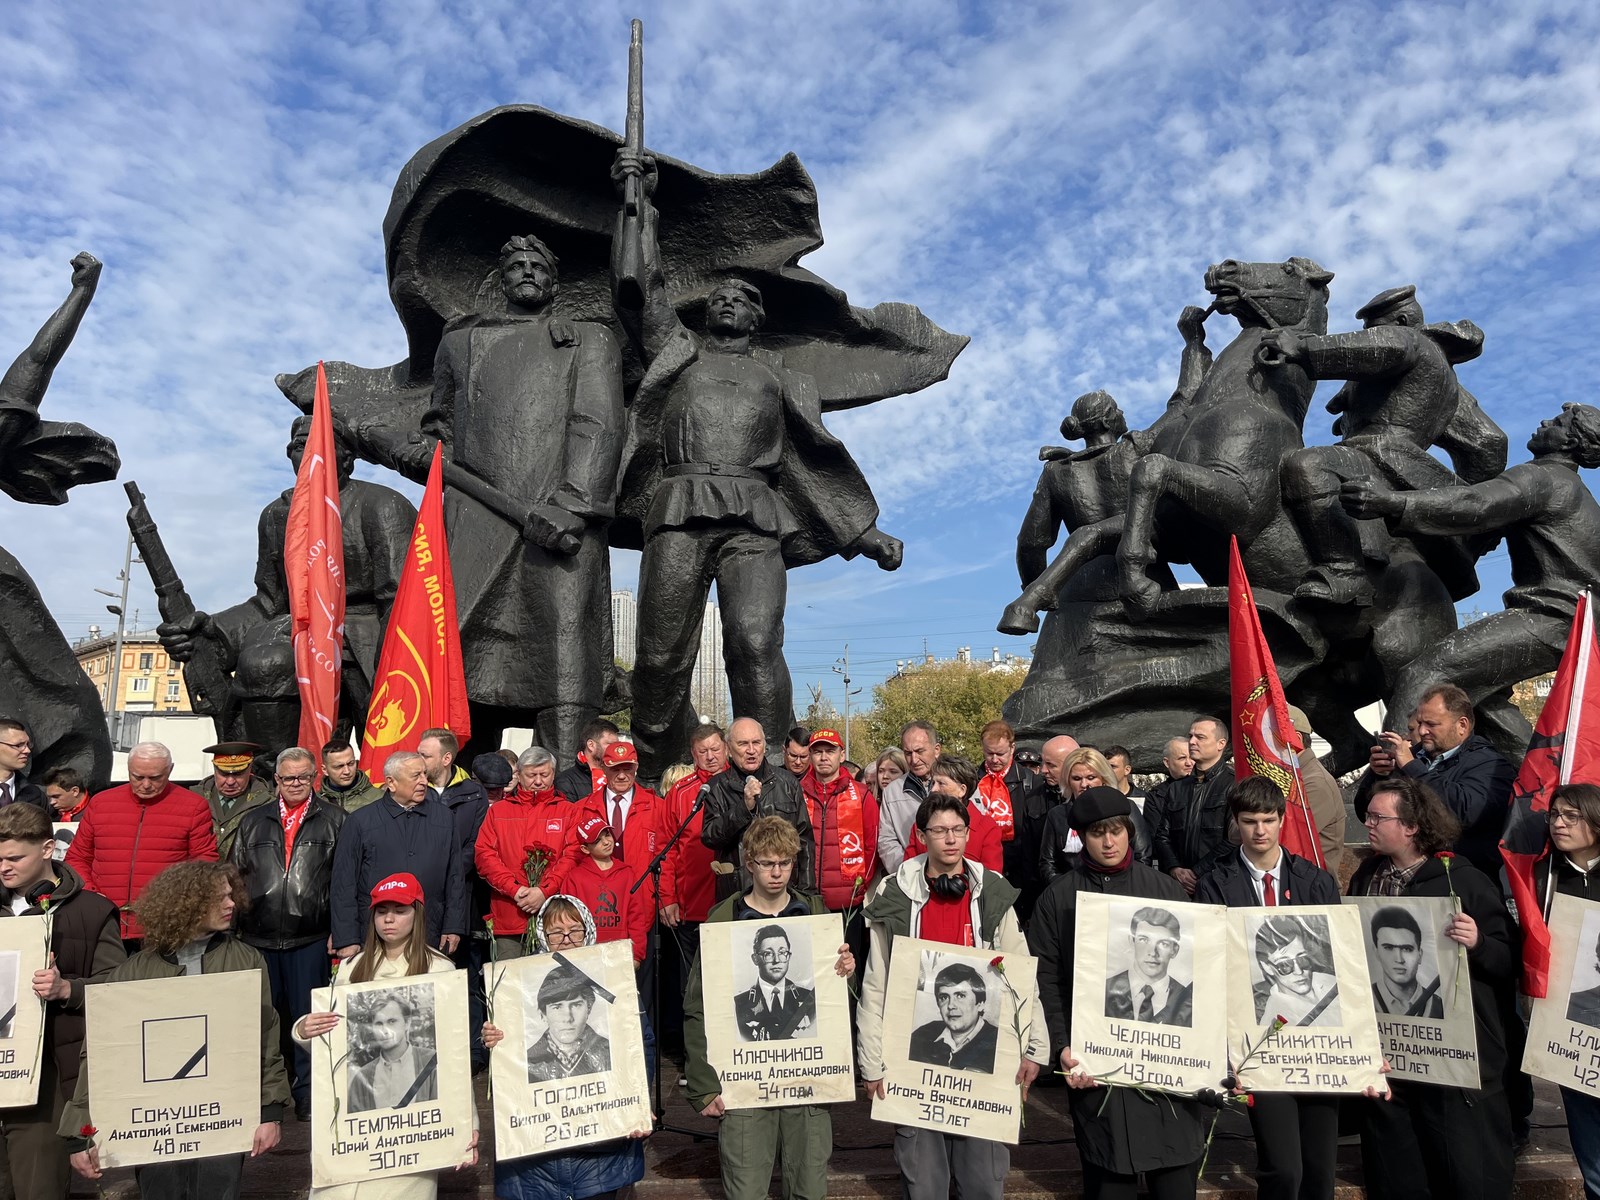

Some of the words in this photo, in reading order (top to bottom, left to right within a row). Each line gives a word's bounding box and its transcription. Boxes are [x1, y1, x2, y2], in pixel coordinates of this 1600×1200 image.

[813, 731, 835, 740] СССР
[378, 880, 408, 892] КПРФ
[1110, 1023, 1182, 1050] ЧЕЛЯКОВ
[1266, 1031, 1353, 1049] НИКИТИН
[1377, 1022, 1443, 1042] АНТЕЛЕЕВ
[733, 1046, 824, 1066] КЛЮЧНИКОВ
[1084, 1041, 1133, 1060] НИКОЛАЙ
[1140, 1048, 1212, 1070] НИКОЛАЕВИЧ
[1261, 1051, 1312, 1065] ЕВГЕНИЙ
[1315, 1052, 1372, 1066] ЮРЬЕВИЧ
[1390, 1038, 1476, 1062] ВЛАДИМИРОВИЧ
[1547, 1040, 1580, 1062] ЮРИЙ
[767, 1064, 851, 1079] АЛЕКСАНДРОВИЧ
[1123, 1062, 1145, 1082] 43
[1147, 1071, 1185, 1088] ГОДА
[1281, 1067, 1310, 1085] 23
[1315, 1074, 1348, 1088] ГОДА
[1408, 1061, 1430, 1075] ЛЕТ
[1573, 1064, 1600, 1089] 42
[758, 1082, 780, 1101] 54
[921, 1068, 973, 1093] ПАПИН
[533, 1080, 607, 1107] ГОГОЛЕВ
[886, 1082, 925, 1100] ИГОРЬ
[930, 1089, 1013, 1116] ВЯЧЕСЛАВОВИЧ
[131, 1101, 221, 1124] СОКУШЕВ
[561, 1095, 641, 1119] ВАЛЕНТИНОВИЧ
[918, 1103, 945, 1124] 38
[946, 1114, 971, 1128] ЛЕТ
[108, 1123, 171, 1142] АНАТОЛИЙ
[176, 1118, 243, 1135] СЕМЕНОВИЧ
[344, 1108, 442, 1136] ТЕМЛЯНЦЕВ
[544, 1122, 572, 1144] 26
[574, 1122, 599, 1139] ЛЕТ
[153, 1138, 175, 1156] 48
[179, 1141, 201, 1154] ЛЕТ
[331, 1137, 369, 1156] ЮРИЙ
[375, 1127, 455, 1150] АНАТОЛЬЕВИЧ
[368, 1149, 396, 1172] 30
[398, 1152, 420, 1168] ЛЕТ
